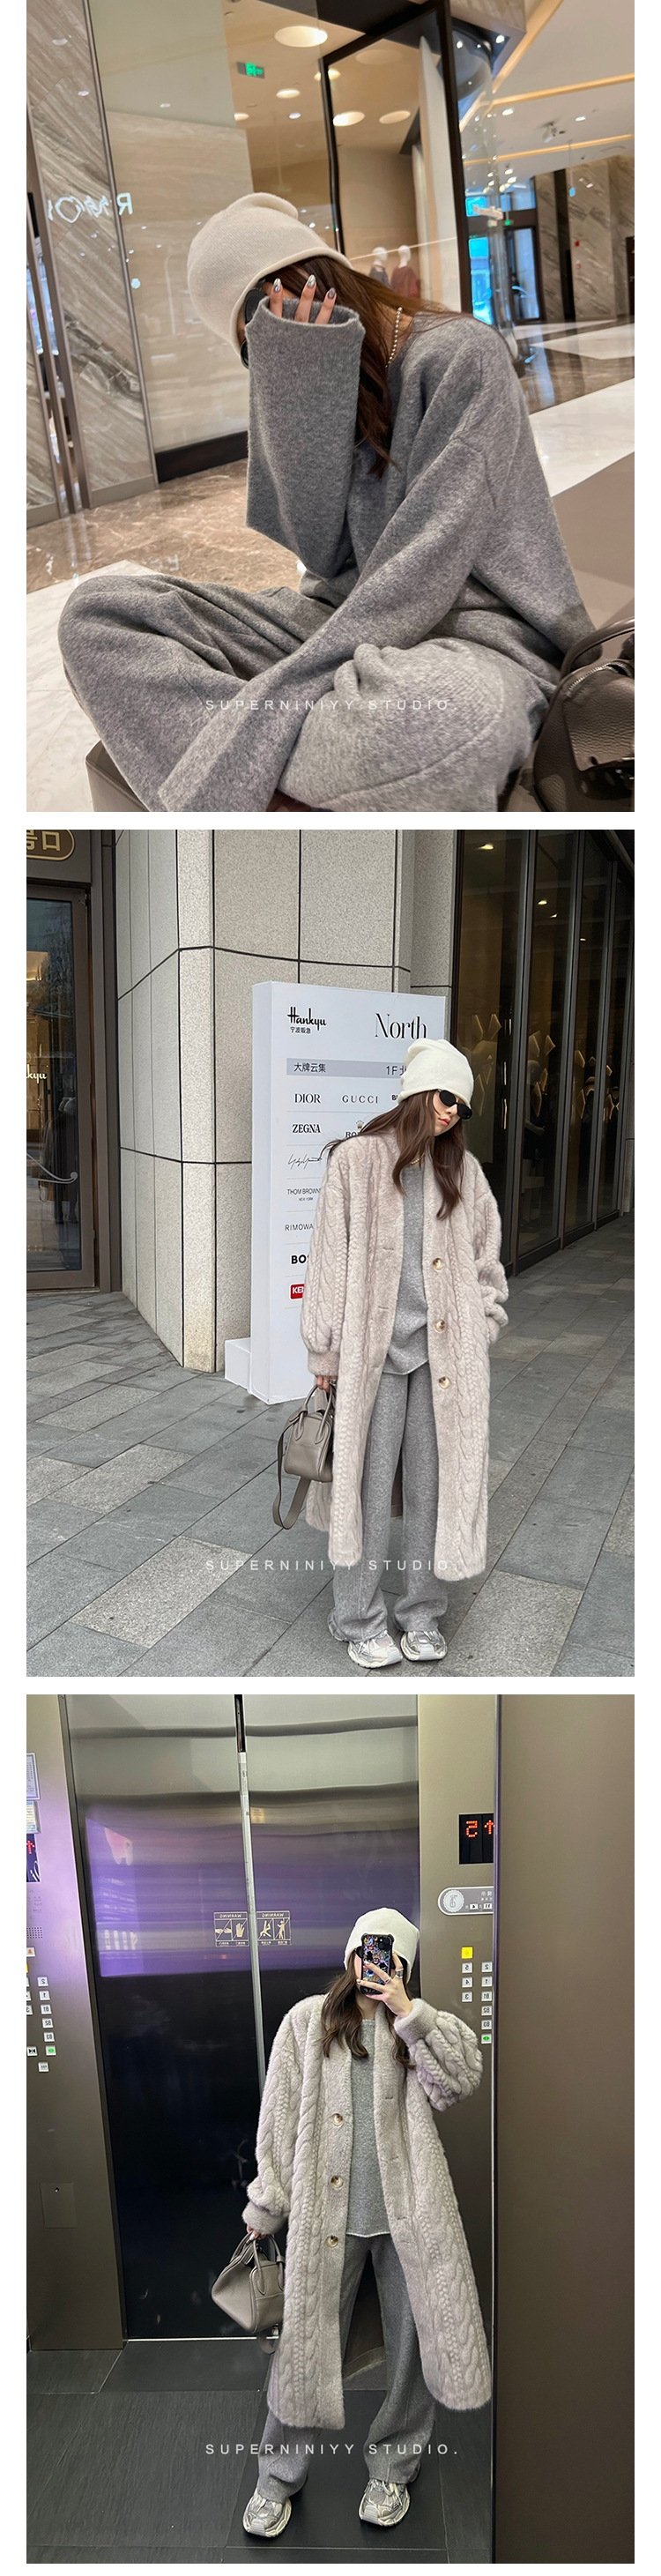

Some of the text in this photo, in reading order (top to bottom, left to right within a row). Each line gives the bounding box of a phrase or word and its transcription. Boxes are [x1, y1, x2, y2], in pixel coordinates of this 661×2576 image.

[287, 1006, 427, 1039] Hankyu North
[293, 1062, 326, 1073] 大牌云集
[386, 1065, 397, 1076] 1F
[294, 1093, 321, 1104] DIOR
[342, 1095, 378, 1104] GUCCI
[292, 1123, 321, 1134] ZEGNA
[285, 1223, 314, 1232] RIMOWA
